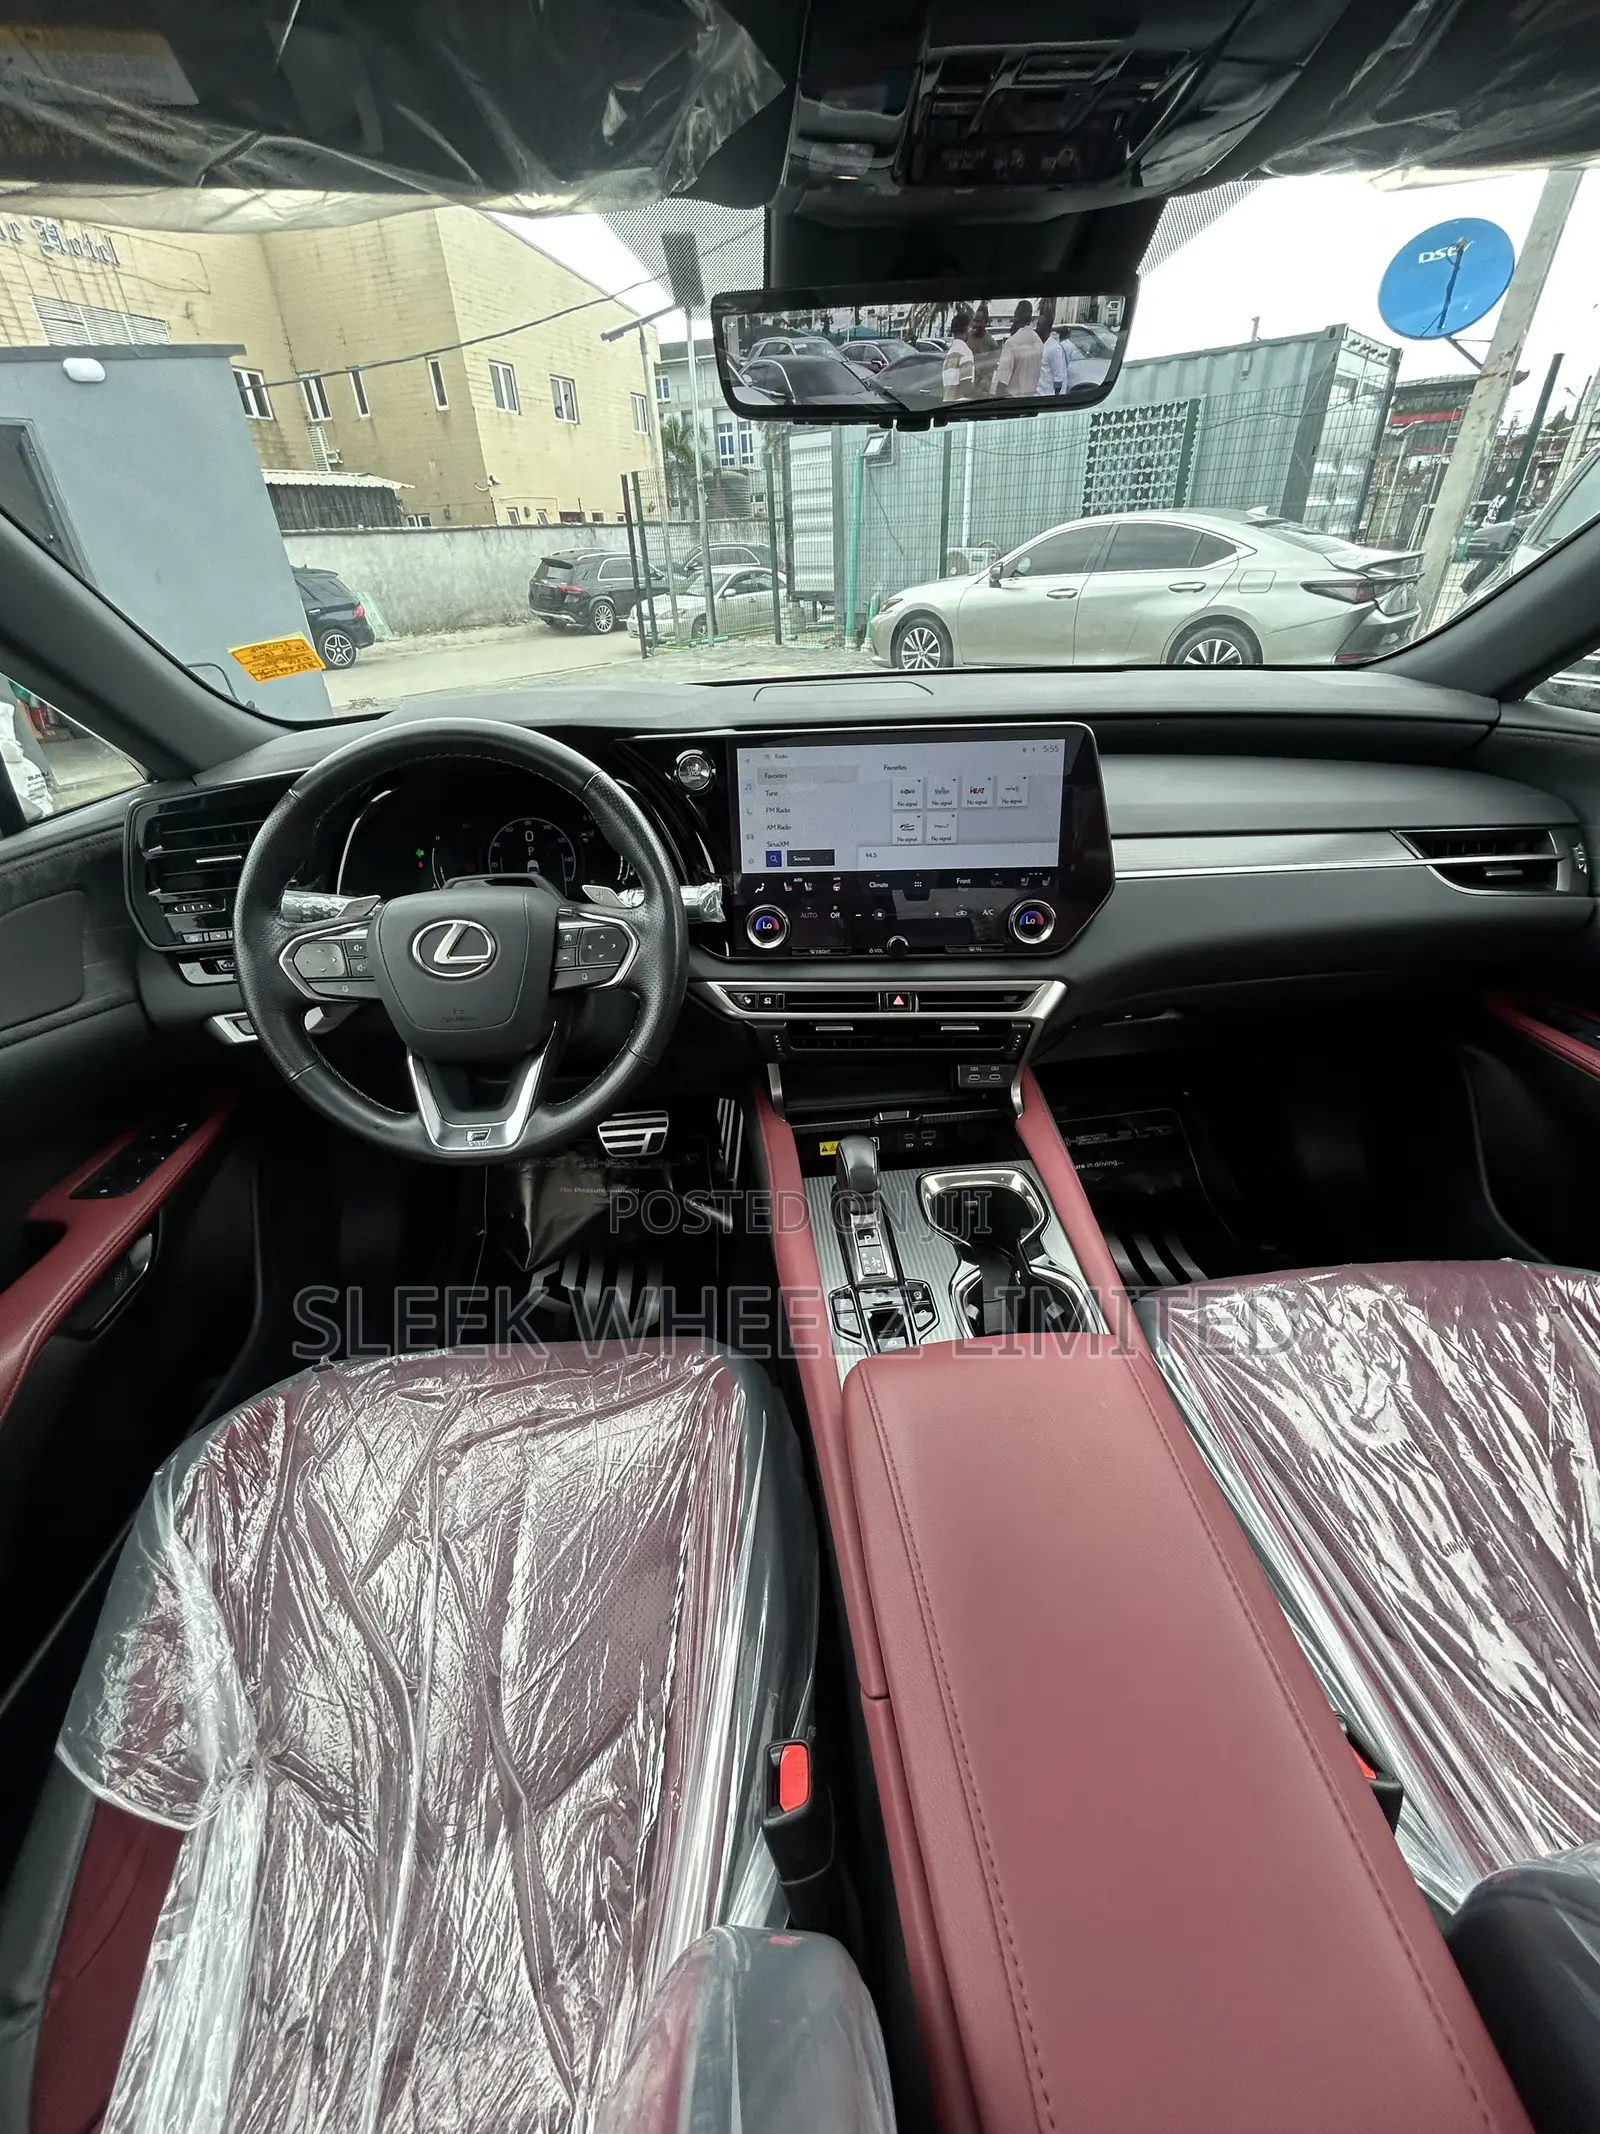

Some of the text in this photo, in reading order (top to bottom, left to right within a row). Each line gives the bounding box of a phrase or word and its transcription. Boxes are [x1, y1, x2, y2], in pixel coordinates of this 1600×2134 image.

[31, 219, 120, 268] Hotel
[1043, 745, 1060, 753] 5:55
[763, 772, 788, 780] Favorites
[905, 800, 918, 809] signal
[940, 800, 953, 808] signal
[975, 799, 988, 807] signal
[1009, 798, 1023, 807] signal
[525, 830, 534, 842] 0
[905, 836, 918, 844] signal
[939, 835, 952, 844] signal
[527, 846, 535, 856] P
[868, 881, 889, 889] Climate
[990, 879, 1003, 887] Sync
[1025, 916, 1036, 925] Lo
[762, 921, 773, 930] Lo
[863, 1234, 872, 1245] P
